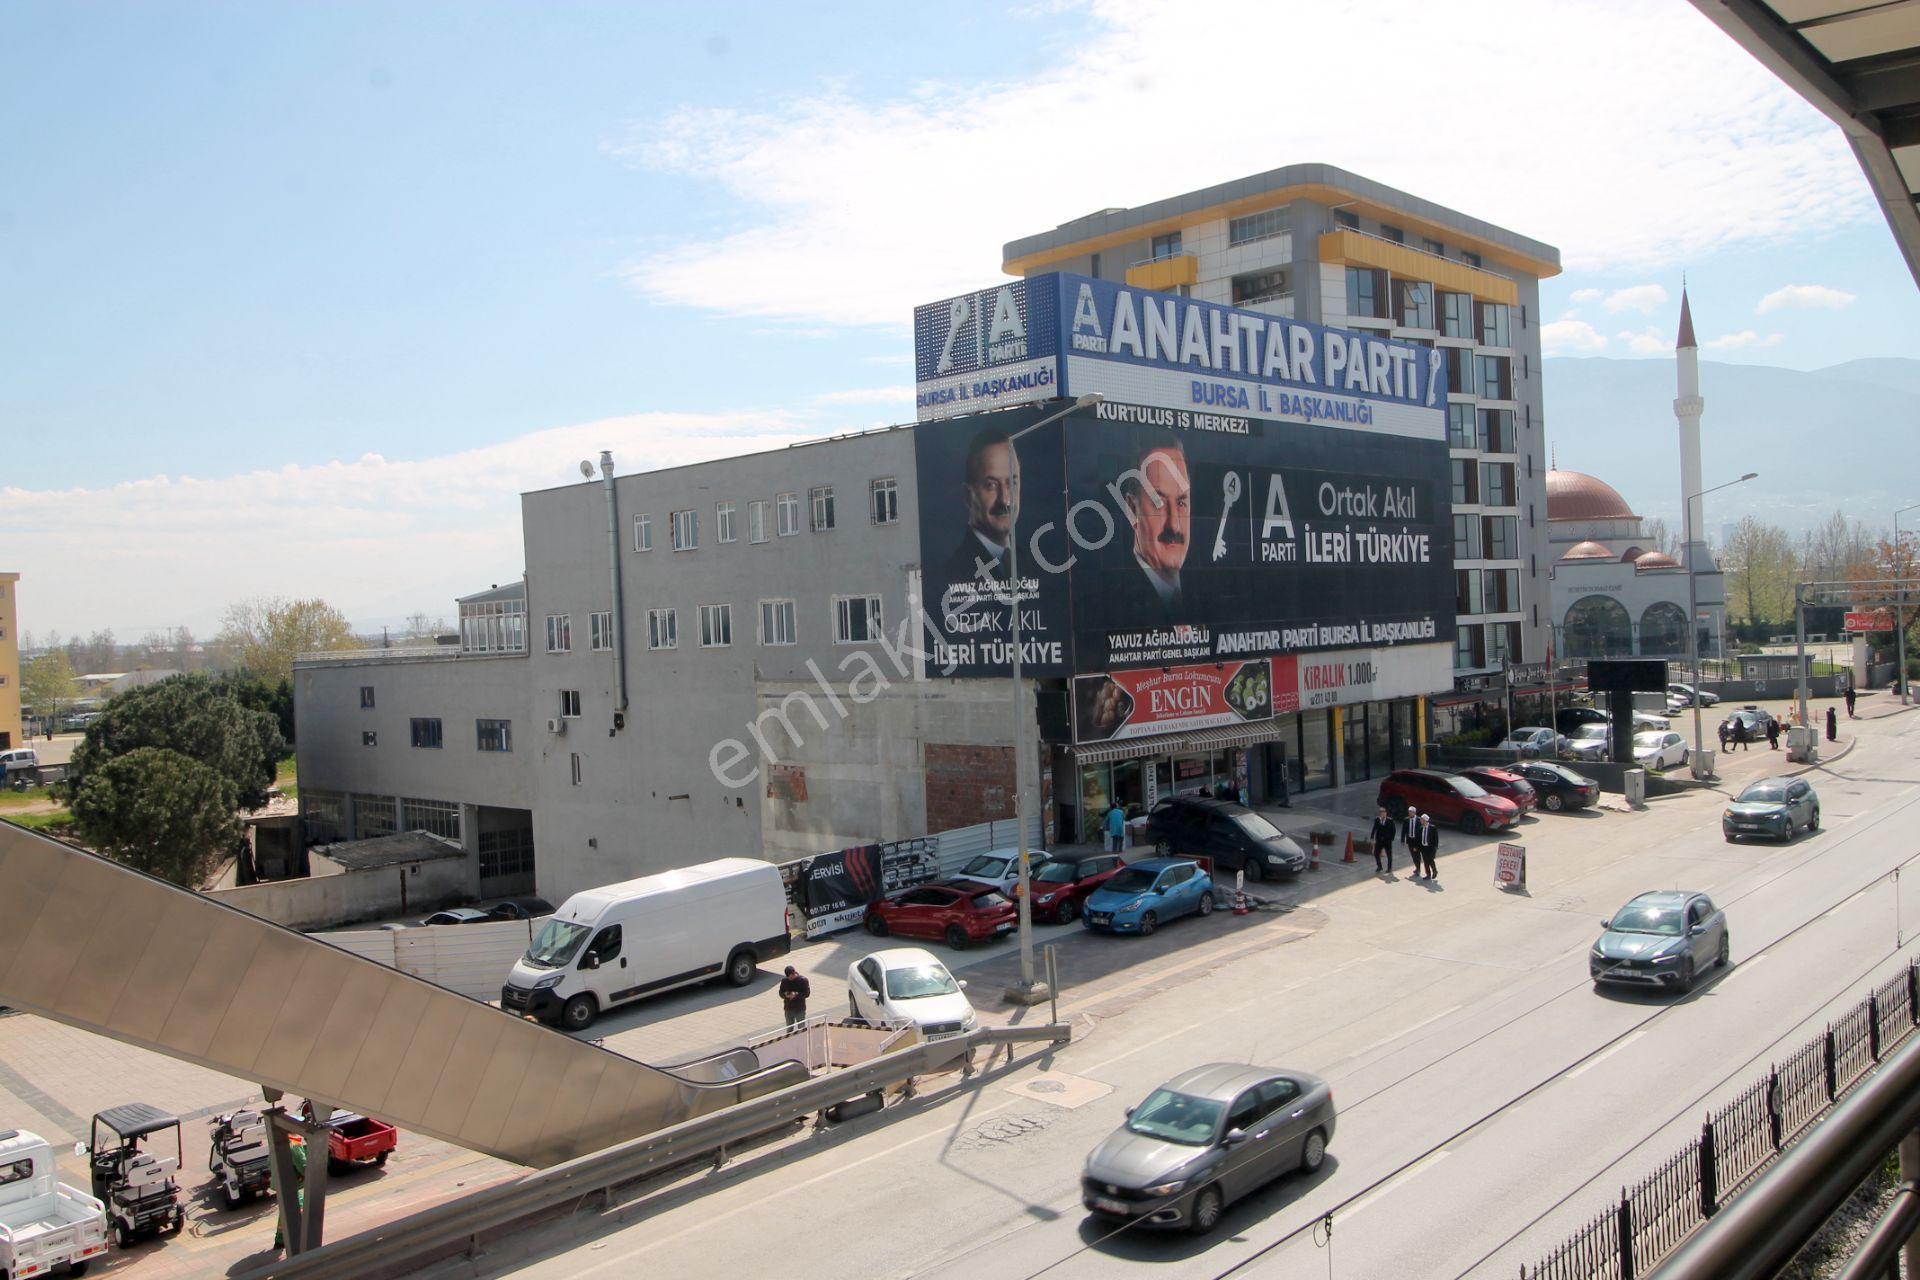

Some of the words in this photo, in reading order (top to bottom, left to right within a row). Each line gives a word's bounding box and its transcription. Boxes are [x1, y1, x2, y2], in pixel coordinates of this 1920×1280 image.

[1109, 291, 1316, 384] ANAHTAR
[916, 387, 956, 408] BURSA
[959, 382, 969, 400] İL
[973, 366, 1054, 399] BAŞKANLIĞI
[1191, 380, 1250, 410] BURSA
[1258, 384, 1273, 413] İL
[1280, 393, 1373, 425] BAŞKANLIĞI
[1096, 402, 1174, 428] KURTULUŞ
[1318, 481, 1378, 518] Ortak
[1383, 485, 1416, 519] Akıl
[1305, 523, 1351, 563] İLERİ
[1356, 526, 1429, 563] TÜRKİYE
[948, 582, 977, 594] YAVUZ
[1014, 591, 1040, 601] AŞKANI
[944, 611, 1003, 634] ORTAK
[1216, 629, 1279, 654] ANAHTAR
[1282, 622, 1318, 649] PARTİ
[1320, 624, 1360, 647] BURSA
[1360, 619, 1372, 642] İL
[1372, 616, 1436, 645] BAŞKANLIĞI
[933, 638, 976, 665] İLERİ
[980, 636, 1062, 664] TÜRKİYE
[1108, 633, 1142, 649] YAVUZ
[1145, 630, 1209, 648] AĞIRALİOĞLU
[1109, 651, 1141, 664] ANAHTAR
[1162, 648, 1183, 659] GENEL
[1184, 647, 1210, 659] BAŞKANI
[1150, 680, 1212, 713] ENGİN
